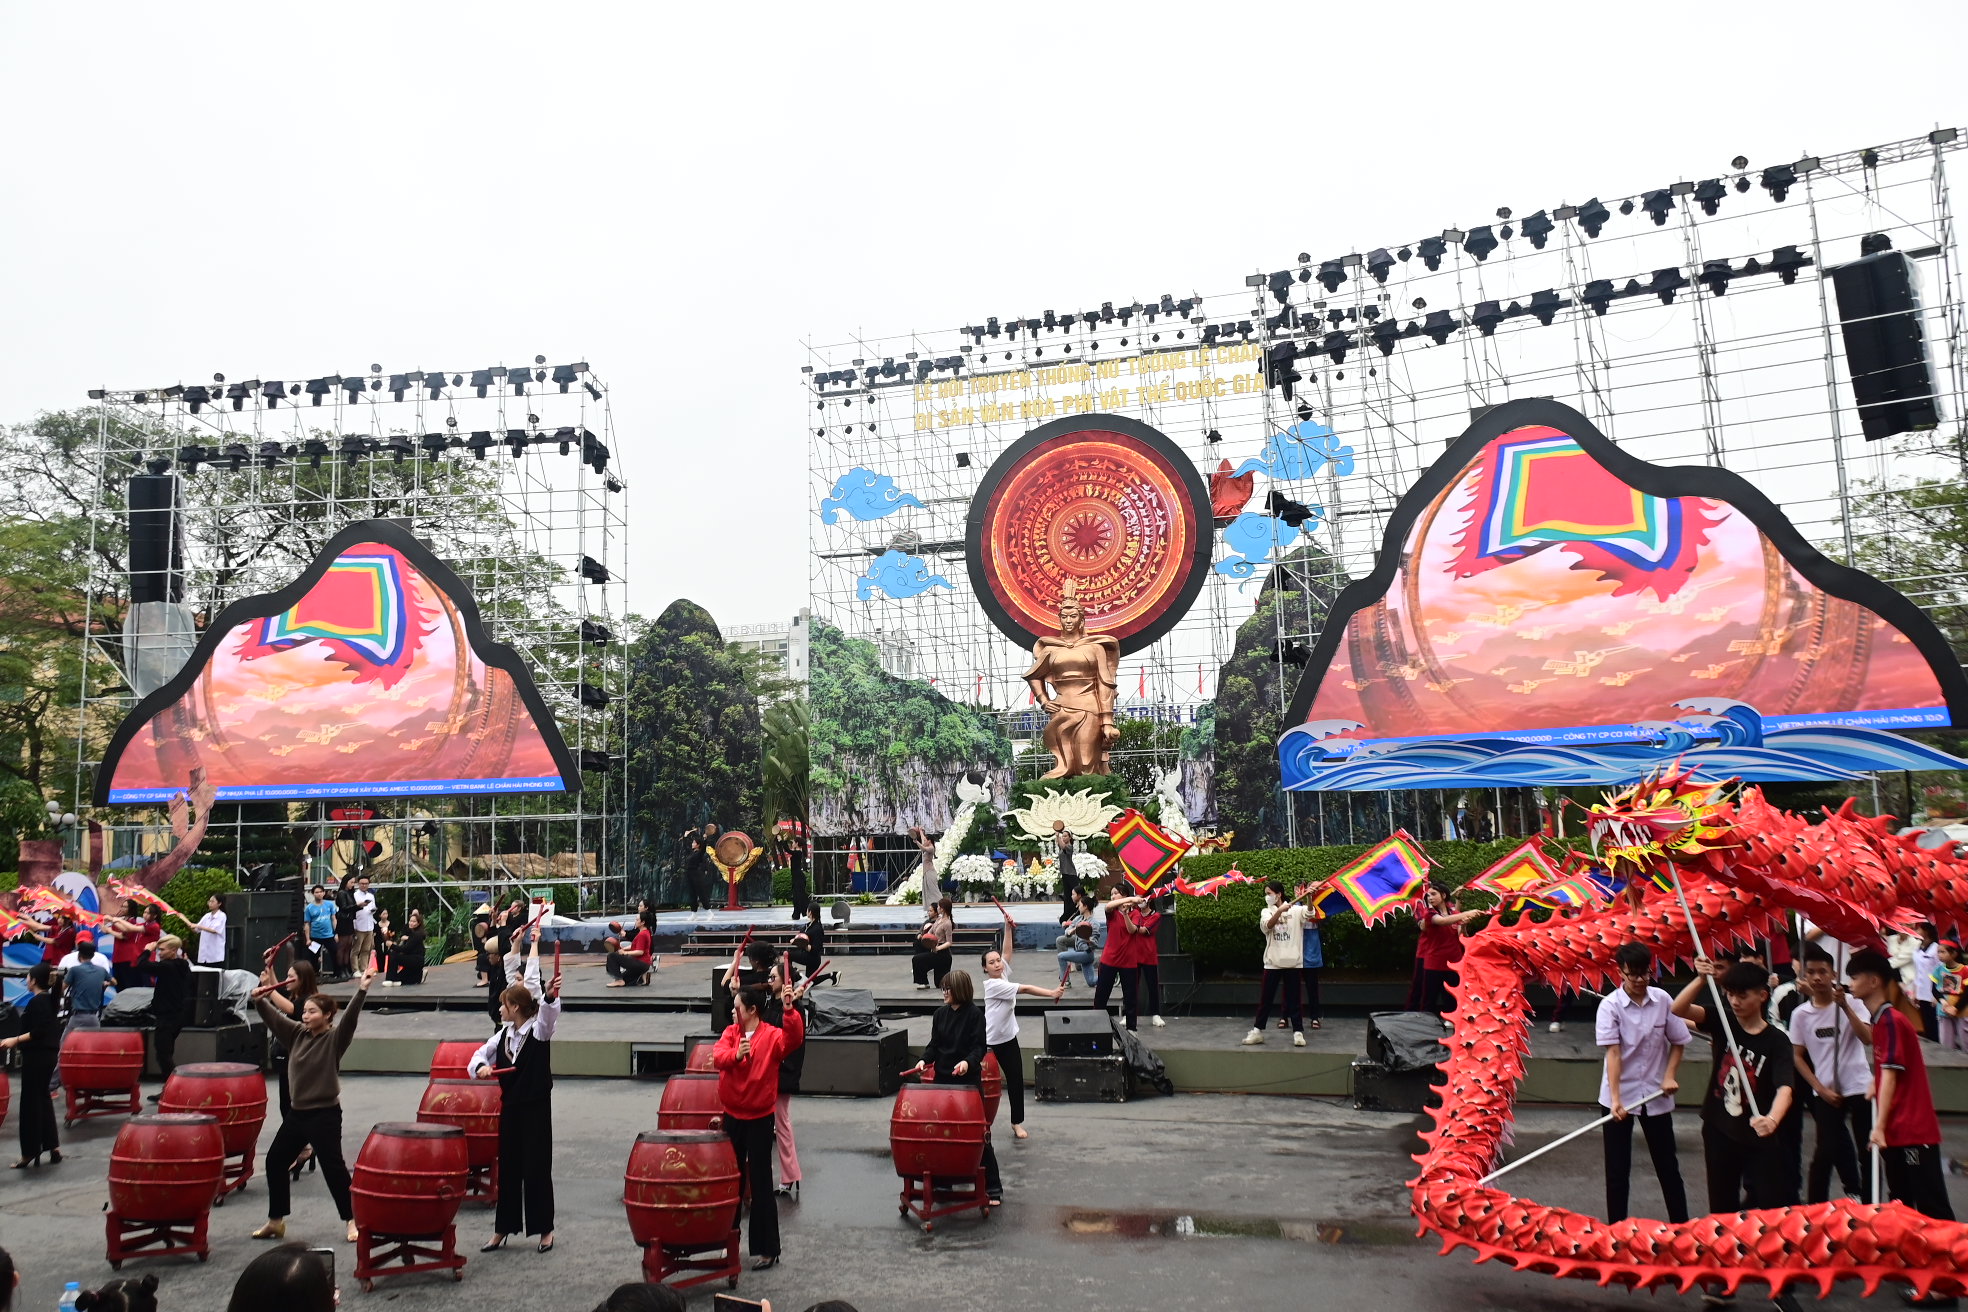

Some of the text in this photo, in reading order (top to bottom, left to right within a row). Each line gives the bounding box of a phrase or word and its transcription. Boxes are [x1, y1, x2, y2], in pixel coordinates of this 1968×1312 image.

[1037, 359, 1091, 386] THỐNG
[1192, 344, 1211, 367] LÊ
[1217, 339, 1264, 365] CHÂN
[938, 401, 975, 428] SẢN
[1063, 393, 1094, 414] PHI
[1099, 385, 1130, 412] VẬT
[1136, 375, 1171, 405] THỂ
[1175, 371, 1227, 402] QUỐC
[1232, 372, 1266, 395] GIA
[1587, 731, 1598, 740] TY
[1598, 731, 1610, 739] CP
